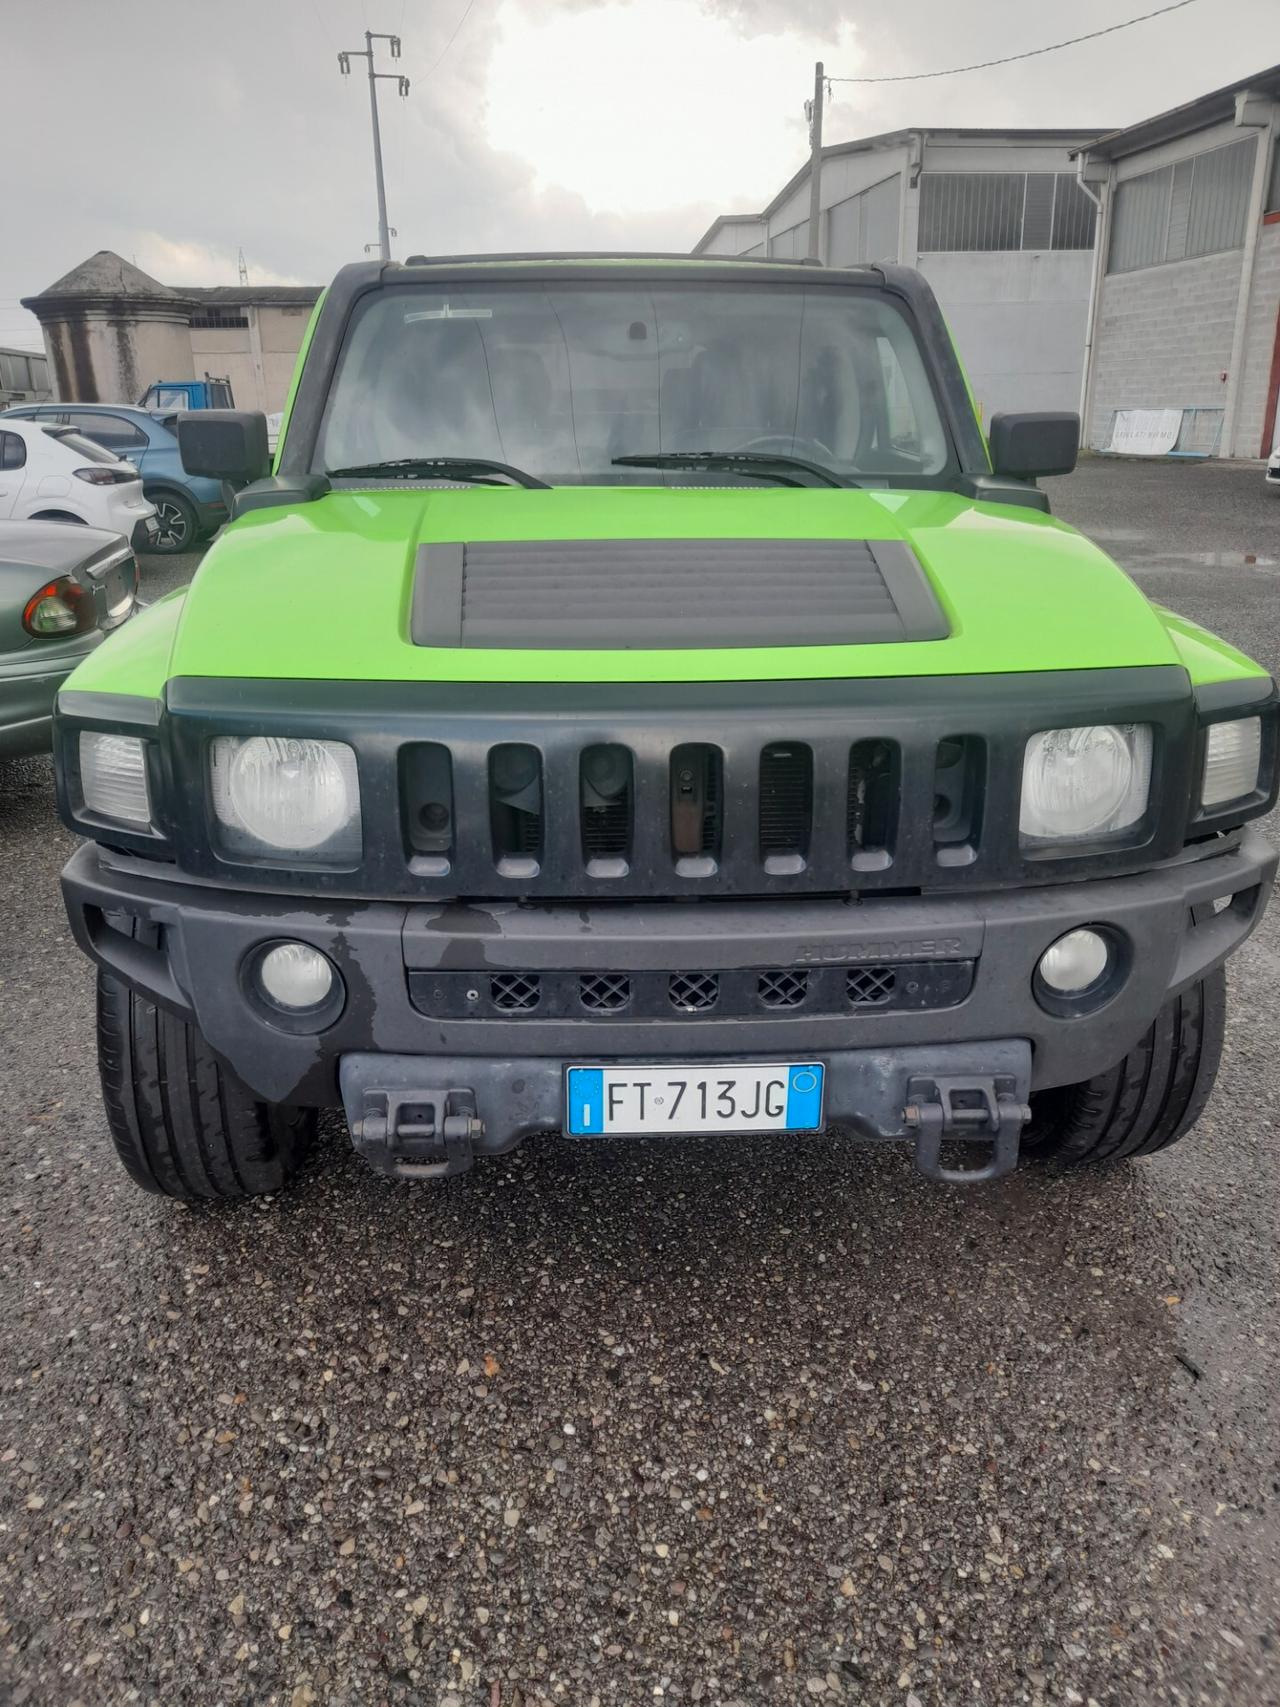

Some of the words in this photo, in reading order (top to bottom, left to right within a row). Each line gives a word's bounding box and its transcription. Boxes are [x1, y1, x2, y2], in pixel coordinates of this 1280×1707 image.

[796, 937, 961, 962] HUMMER
[608, 1082, 652, 1121] FT
[667, 1080, 785, 1120] 713JG
